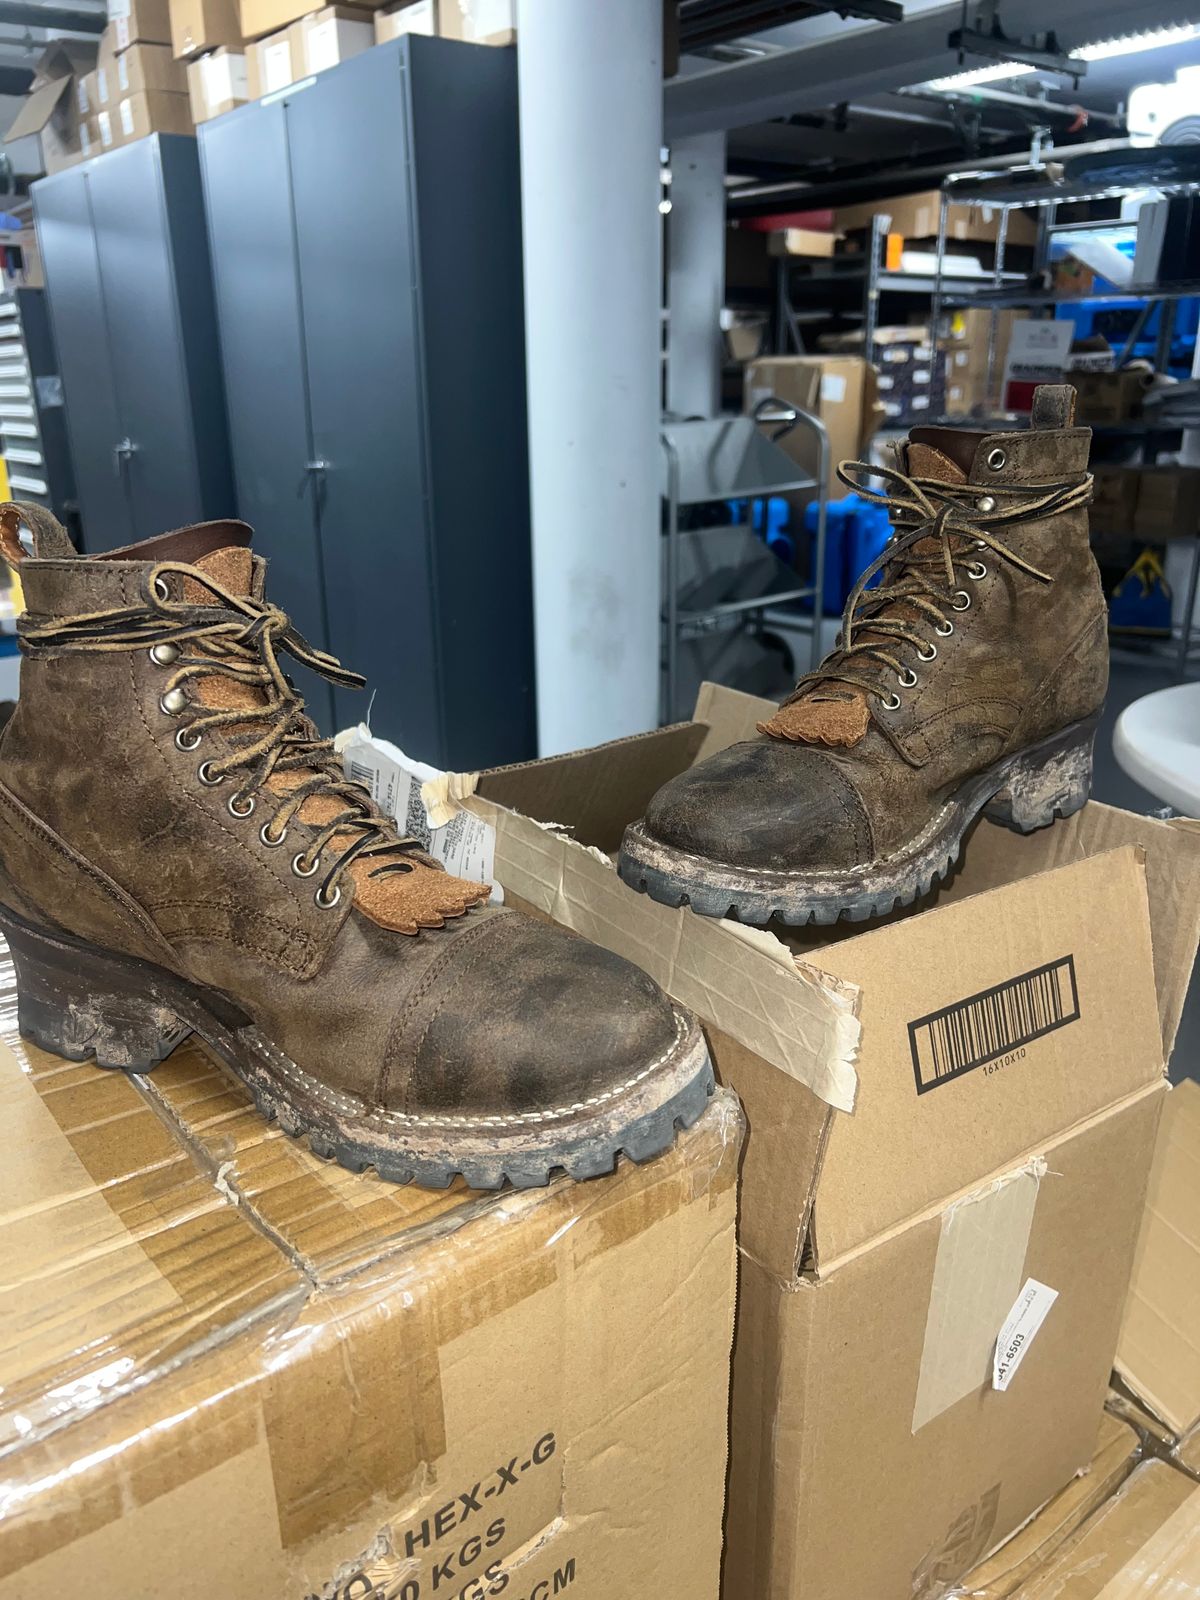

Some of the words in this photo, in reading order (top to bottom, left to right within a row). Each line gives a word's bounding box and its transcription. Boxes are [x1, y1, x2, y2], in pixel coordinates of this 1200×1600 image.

[983, 1048, 1026, 1076] 16X10X10
[405, 1432, 556, 1557] HEX-X-G
[432, 1517, 506, 1591] KGS
[521, 1557, 576, 1600] CM
